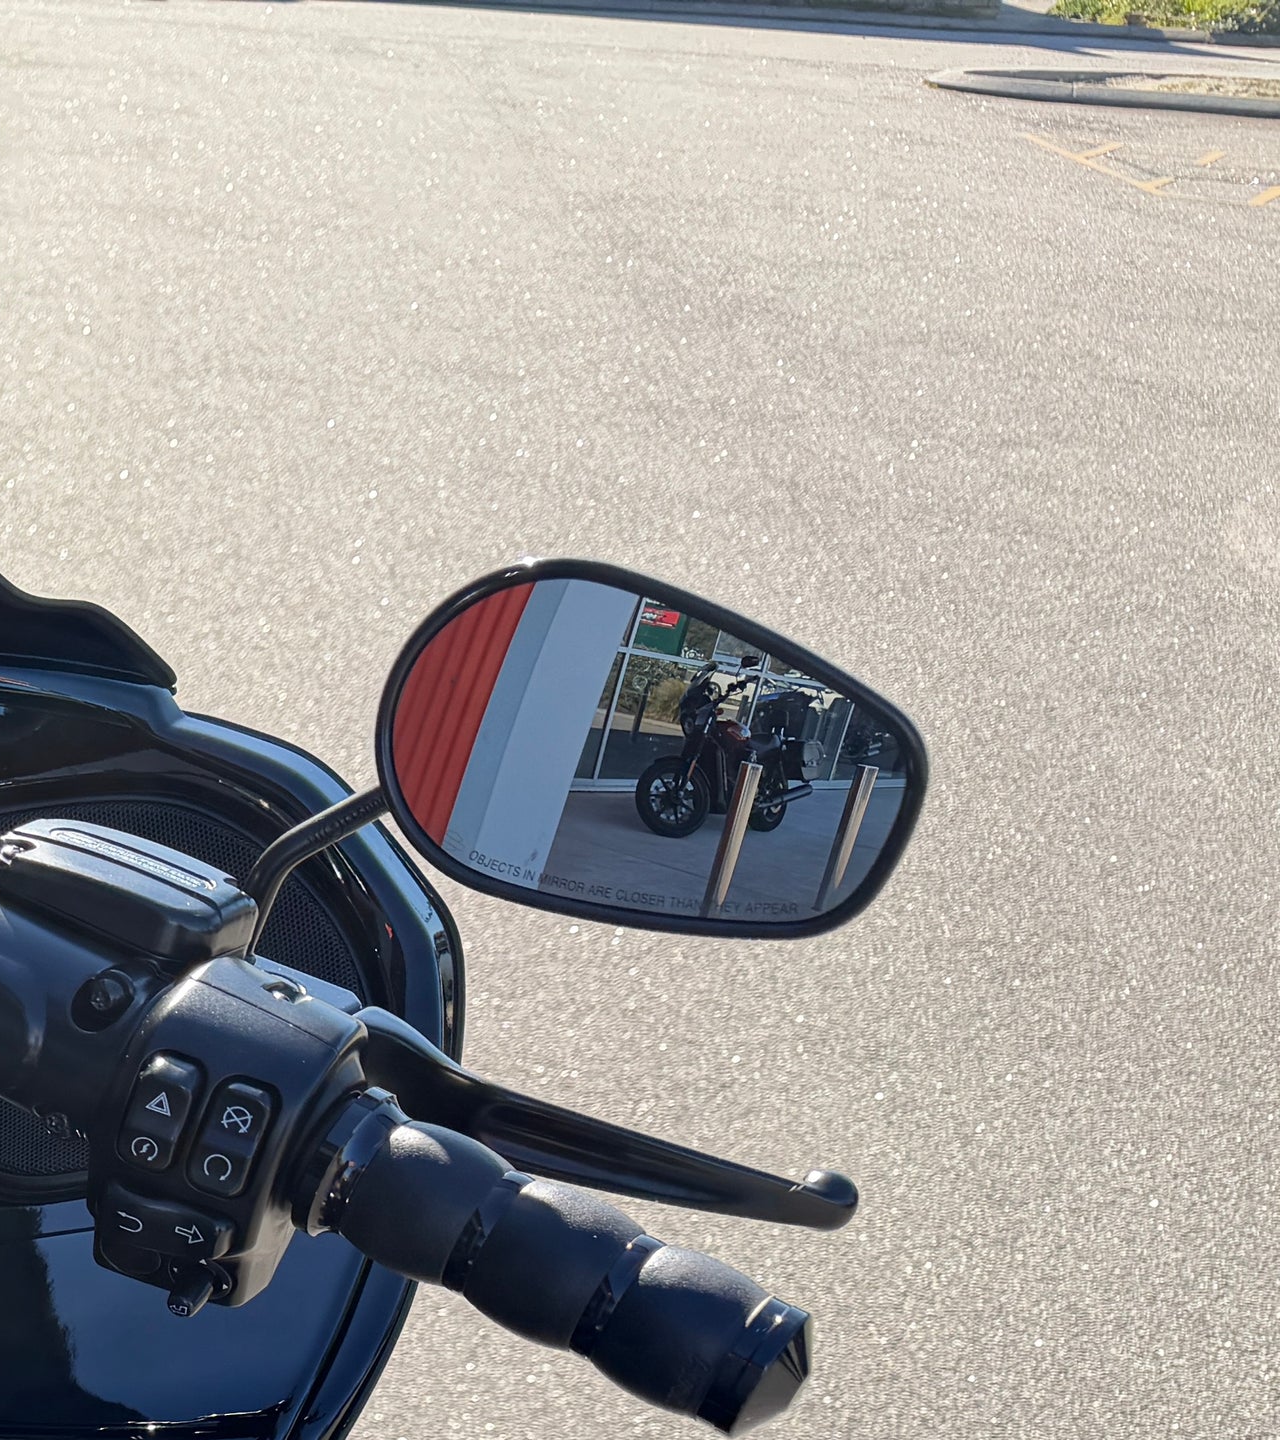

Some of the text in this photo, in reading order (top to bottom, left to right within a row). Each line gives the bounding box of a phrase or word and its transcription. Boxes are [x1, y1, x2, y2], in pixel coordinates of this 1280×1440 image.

[469, 850, 521, 878] OBJECTS
[523, 869, 536, 882] IN
[538, 873, 584, 893] MIRROR
[589, 885, 613, 900] ARE
[615, 889, 665, 908] CLOSER
[745, 902, 799, 915] APPEAR
